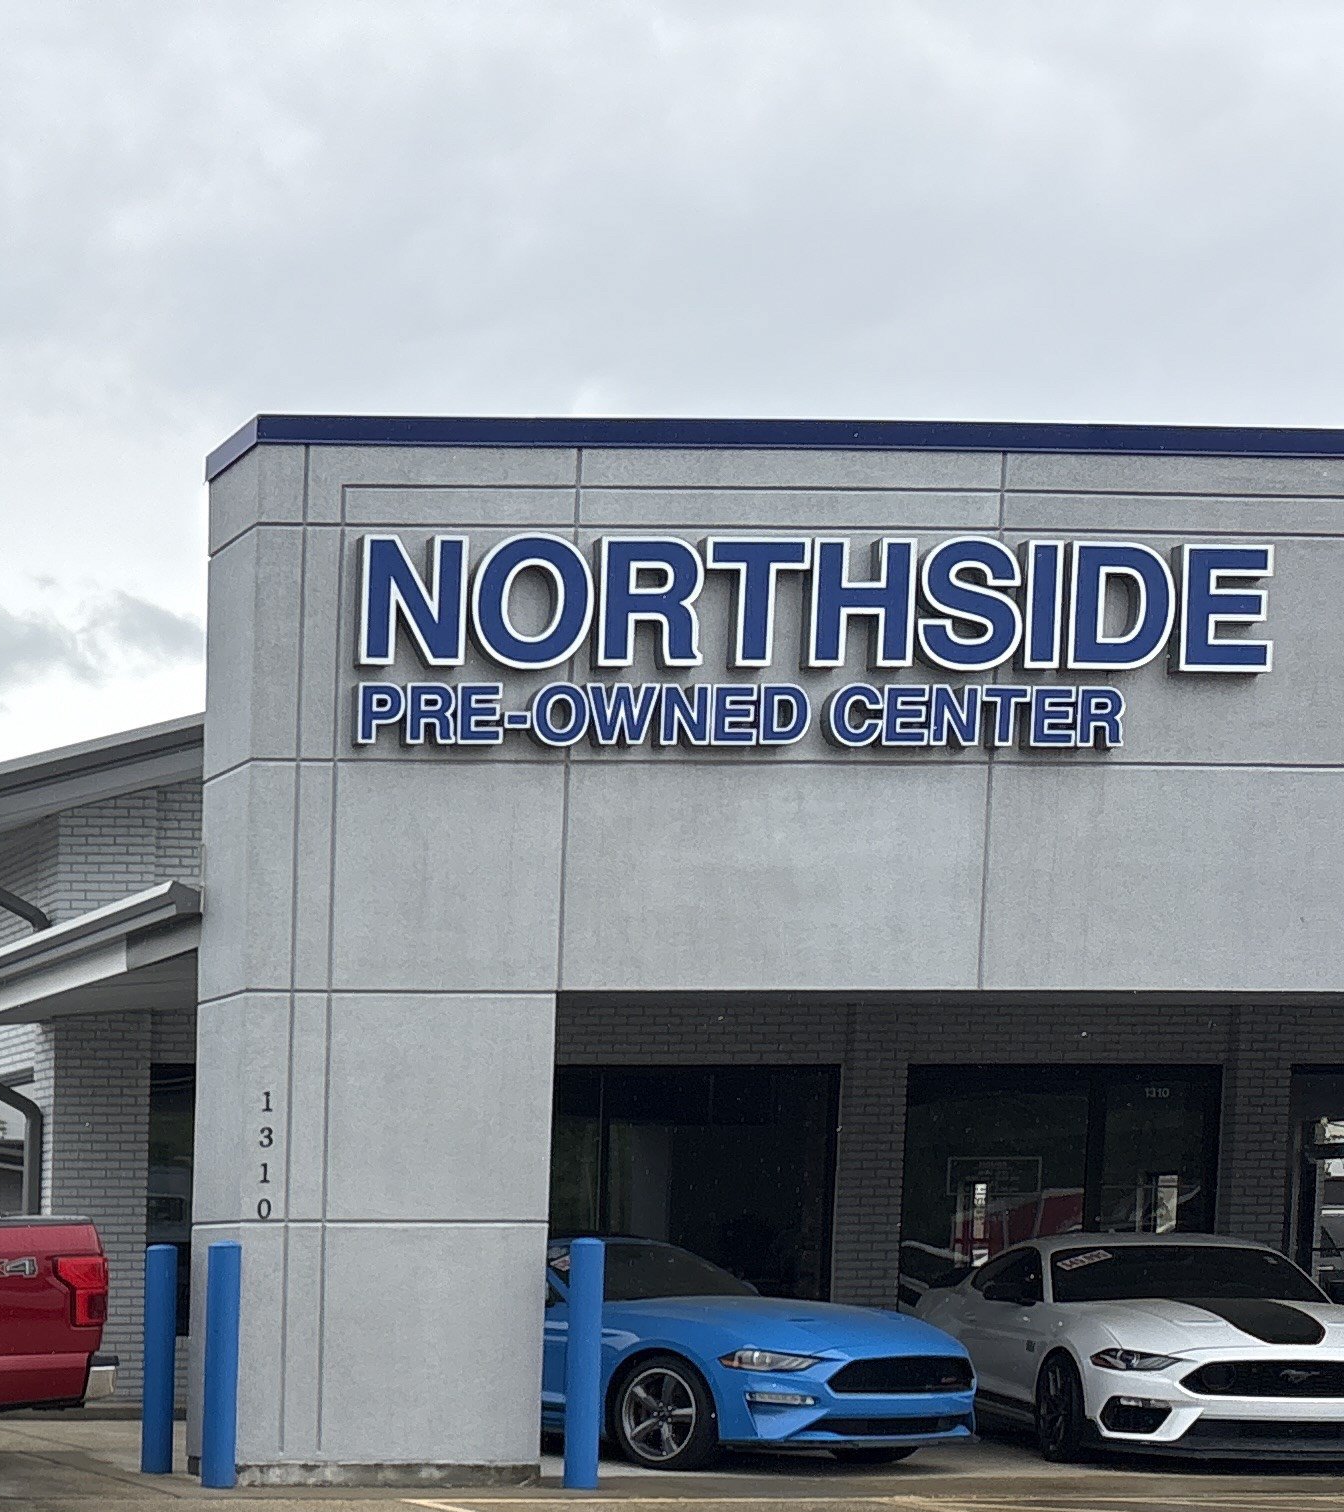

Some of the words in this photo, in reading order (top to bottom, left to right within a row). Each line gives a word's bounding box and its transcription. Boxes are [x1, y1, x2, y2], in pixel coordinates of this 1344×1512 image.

[356, 532, 1274, 674] NORTHSIDE
[354, 682, 811, 747] PRE-OWNED
[823, 684, 1126, 749] CENTER
[1144, 1087, 1170, 1099] 1310
[256, 1090, 274, 1220] 1310
